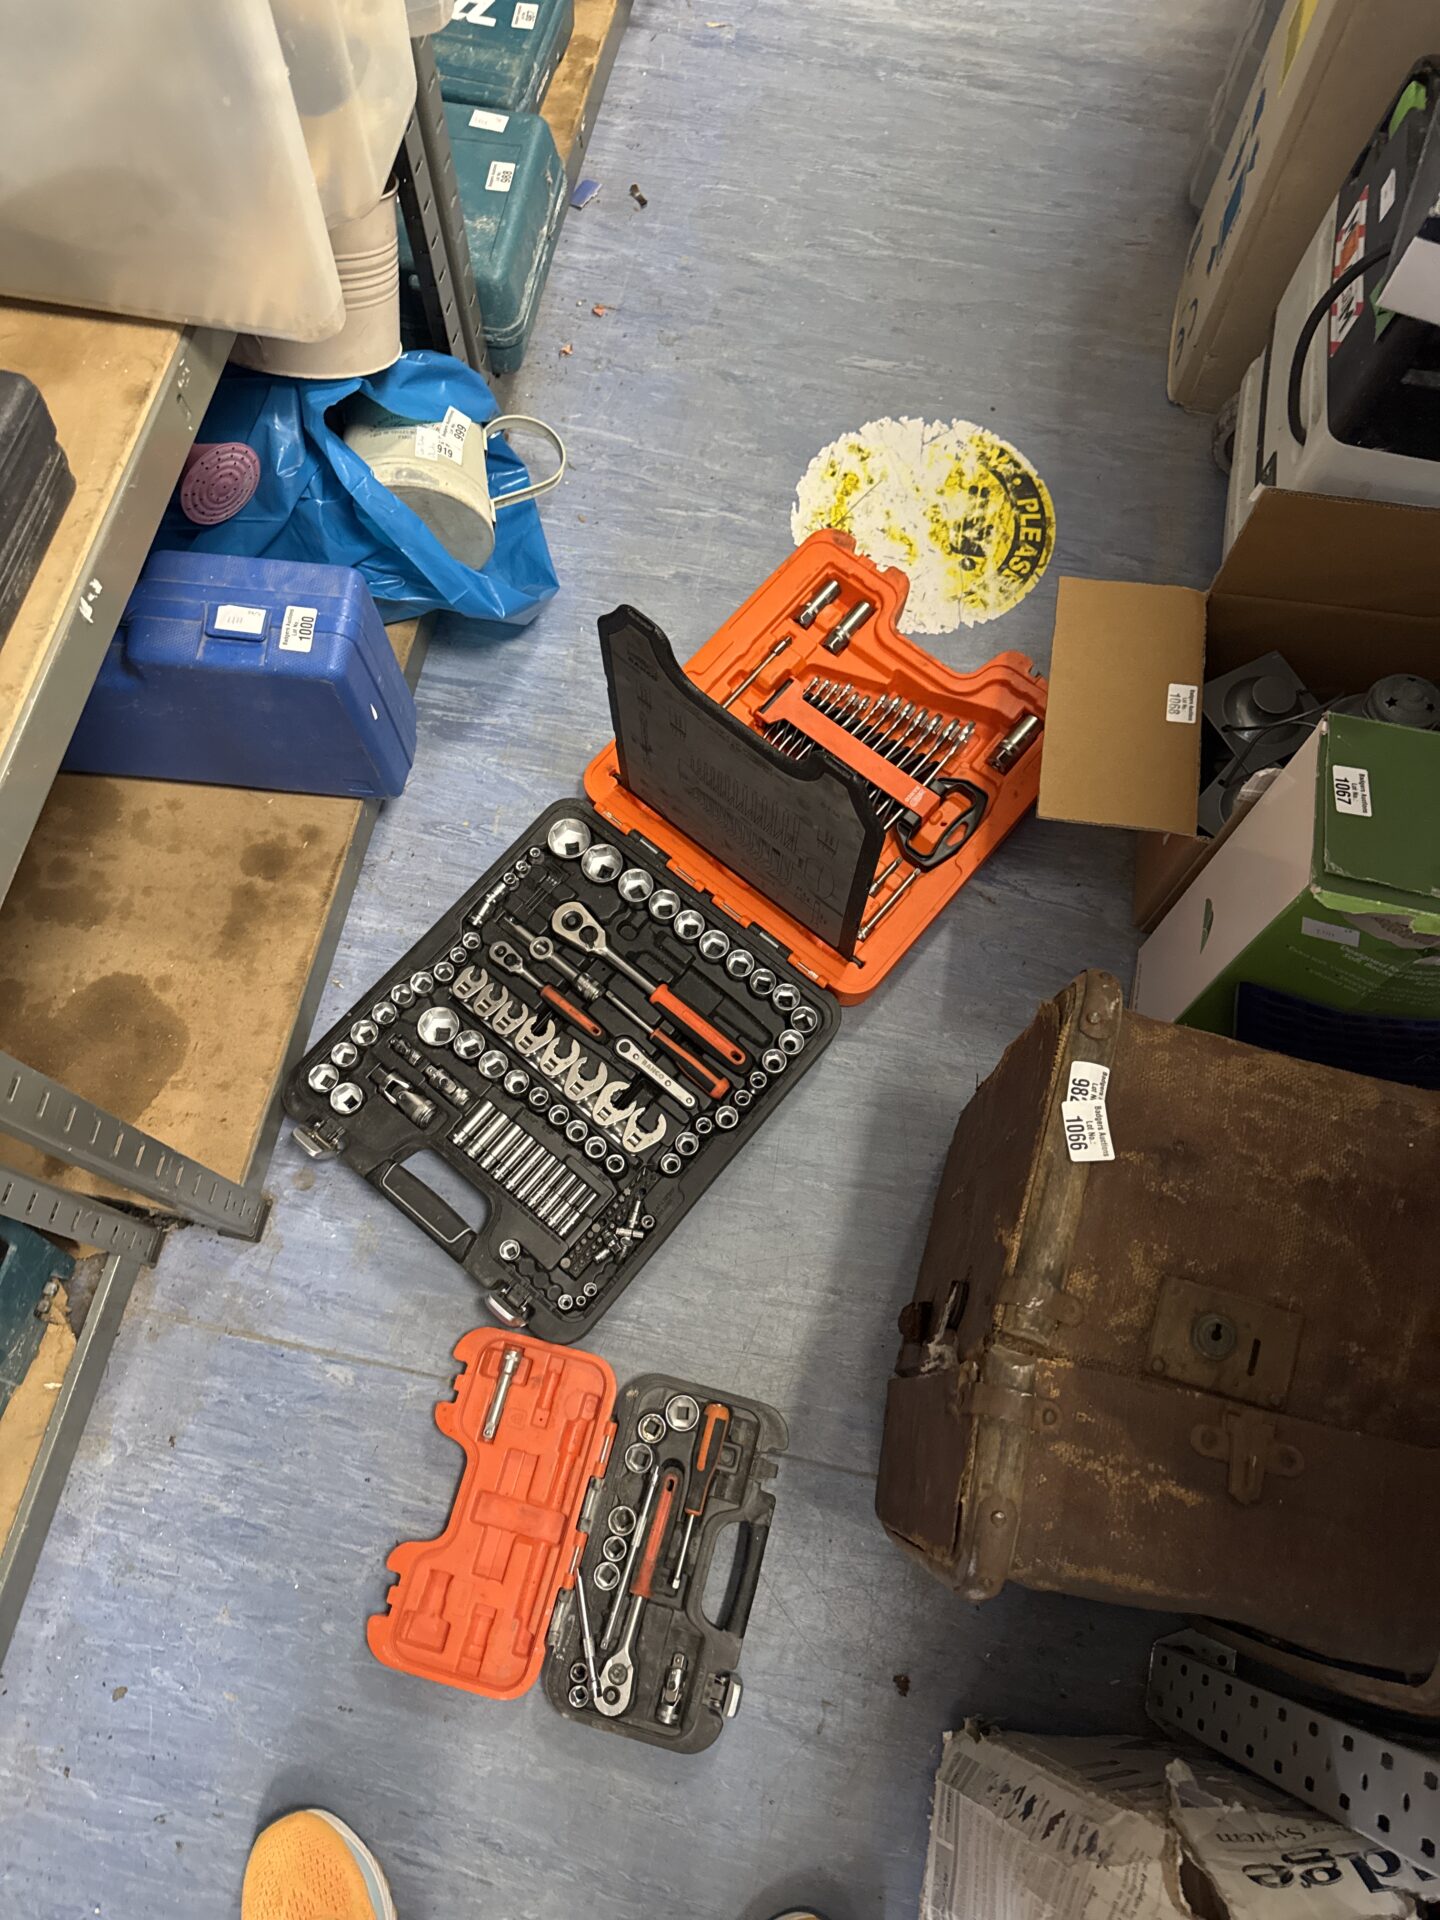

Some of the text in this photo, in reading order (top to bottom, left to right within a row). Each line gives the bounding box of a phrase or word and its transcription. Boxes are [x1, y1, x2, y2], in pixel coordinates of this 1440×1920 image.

[453, 423, 467, 441] 999
[436, 444, 453, 458] 919
[282, 608, 295, 646] Badgers Auctions
[299, 616, 314, 641] 1000
[1168, 692, 1182, 715] 1068
[1335, 777, 1352, 805] 1067
[1358, 773, 1369, 813] Badgers Auctions
[1091, 1082, 1099, 1093] Lot
[1098, 1071, 1108, 1096] Badgers
[1085, 1120, 1095, 1130] Lot
[1094, 1105, 1104, 1130] Badgers
[1065, 1115, 1089, 1151] 1066
[1098, 1131, 1110, 1157] Auctions
[1215, 1825, 1307, 1845] System
